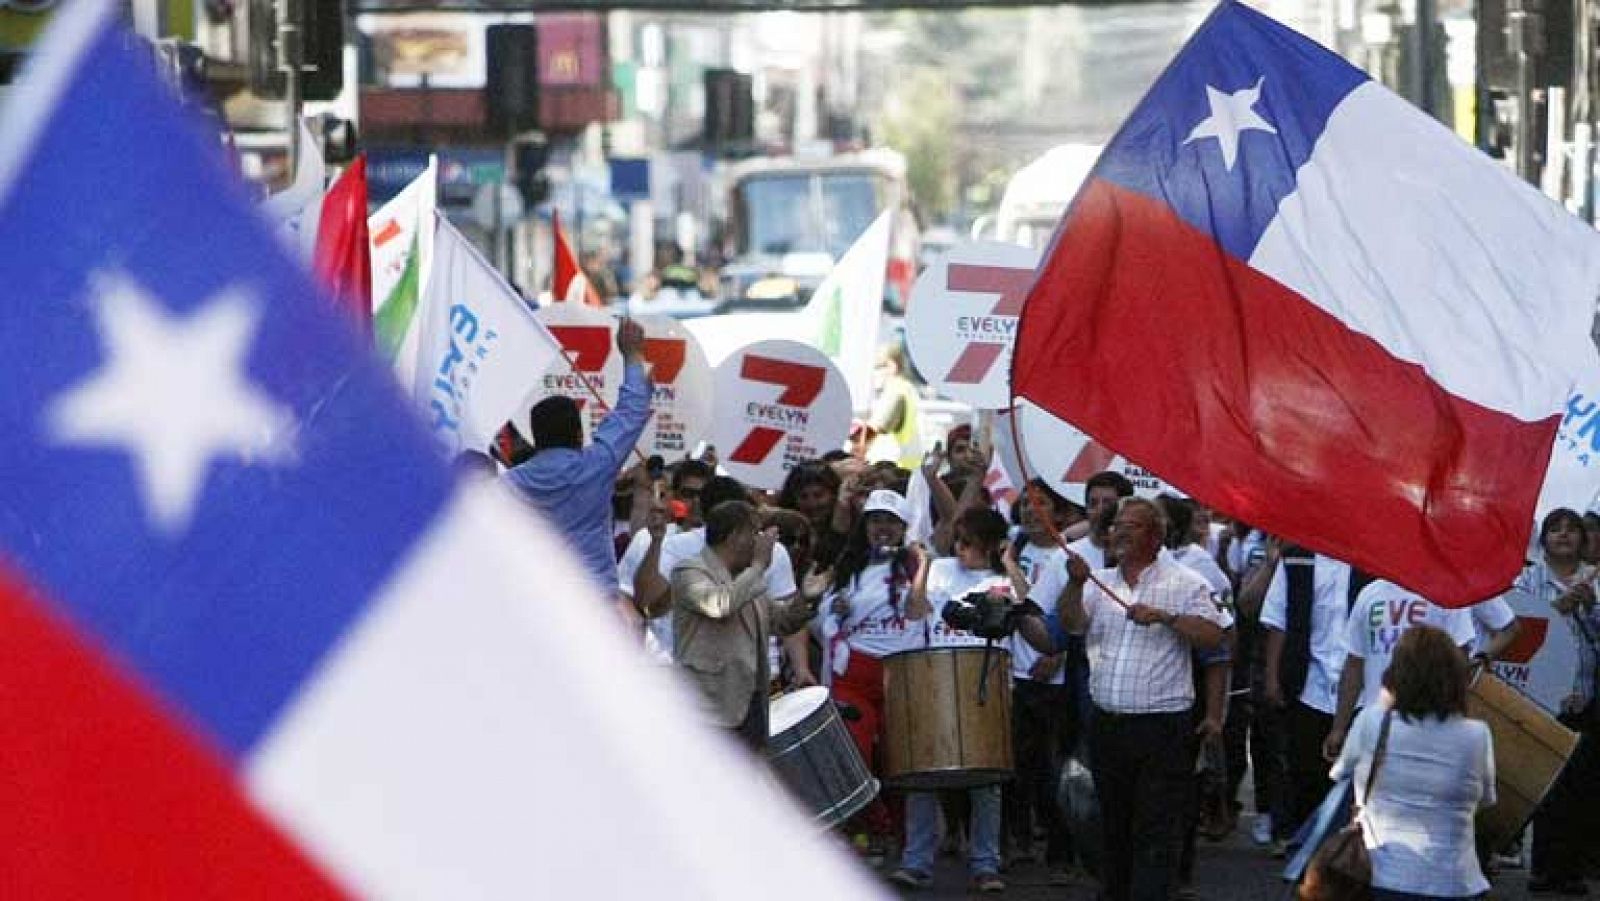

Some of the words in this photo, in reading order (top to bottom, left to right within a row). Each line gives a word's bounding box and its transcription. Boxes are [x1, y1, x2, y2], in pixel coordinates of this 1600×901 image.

[729, 354, 827, 464] 7
[747, 402, 808, 424] EVELYN
[1368, 600, 1428, 626] EVE
